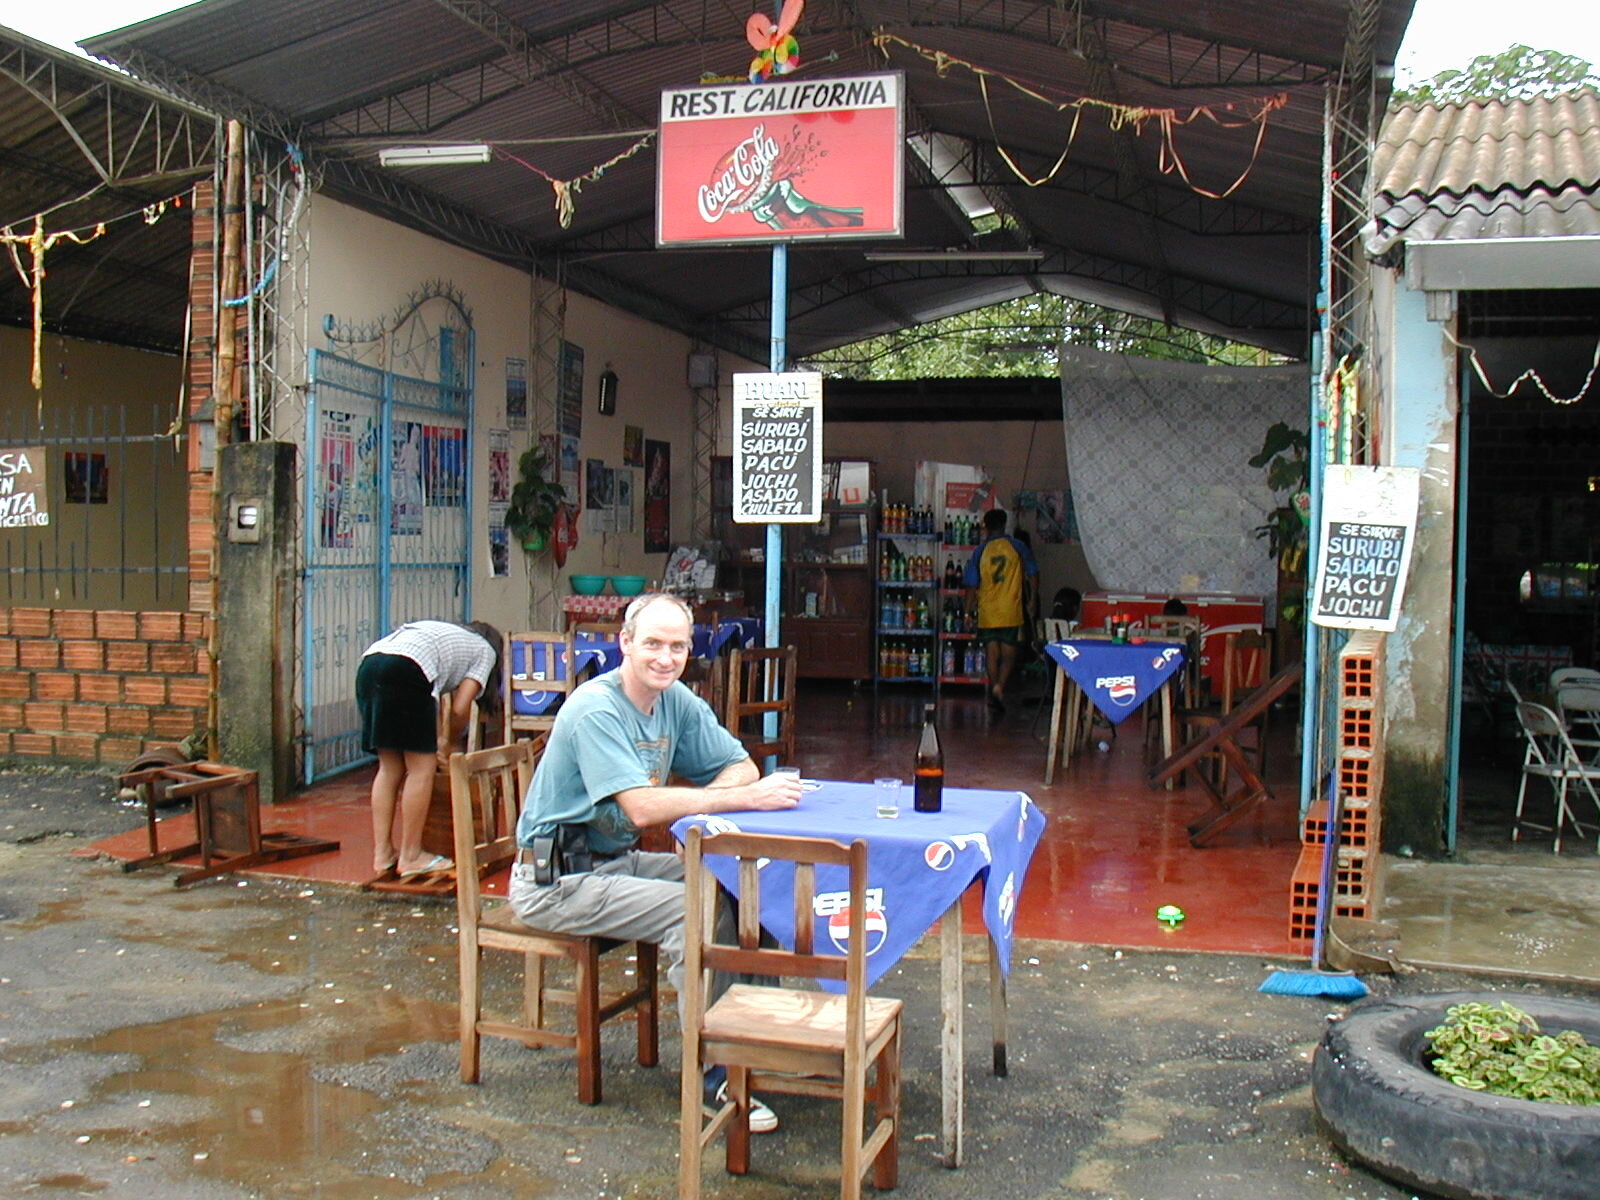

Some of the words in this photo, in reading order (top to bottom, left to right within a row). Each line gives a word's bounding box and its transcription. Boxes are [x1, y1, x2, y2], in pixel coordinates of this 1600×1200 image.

[670, 90, 736, 118] REST.
[743, 80, 887, 114] CALIFORNIA
[752, 407, 770, 418] SE
[769, 406, 805, 419] SIRVE
[742, 473, 798, 490] JOCHI
[742, 487, 799, 504] ASADO
[1339, 524, 1360, 536] SE
[1319, 596, 1384, 617] JOCHI
[1095, 675, 1136, 689] PEPSI
